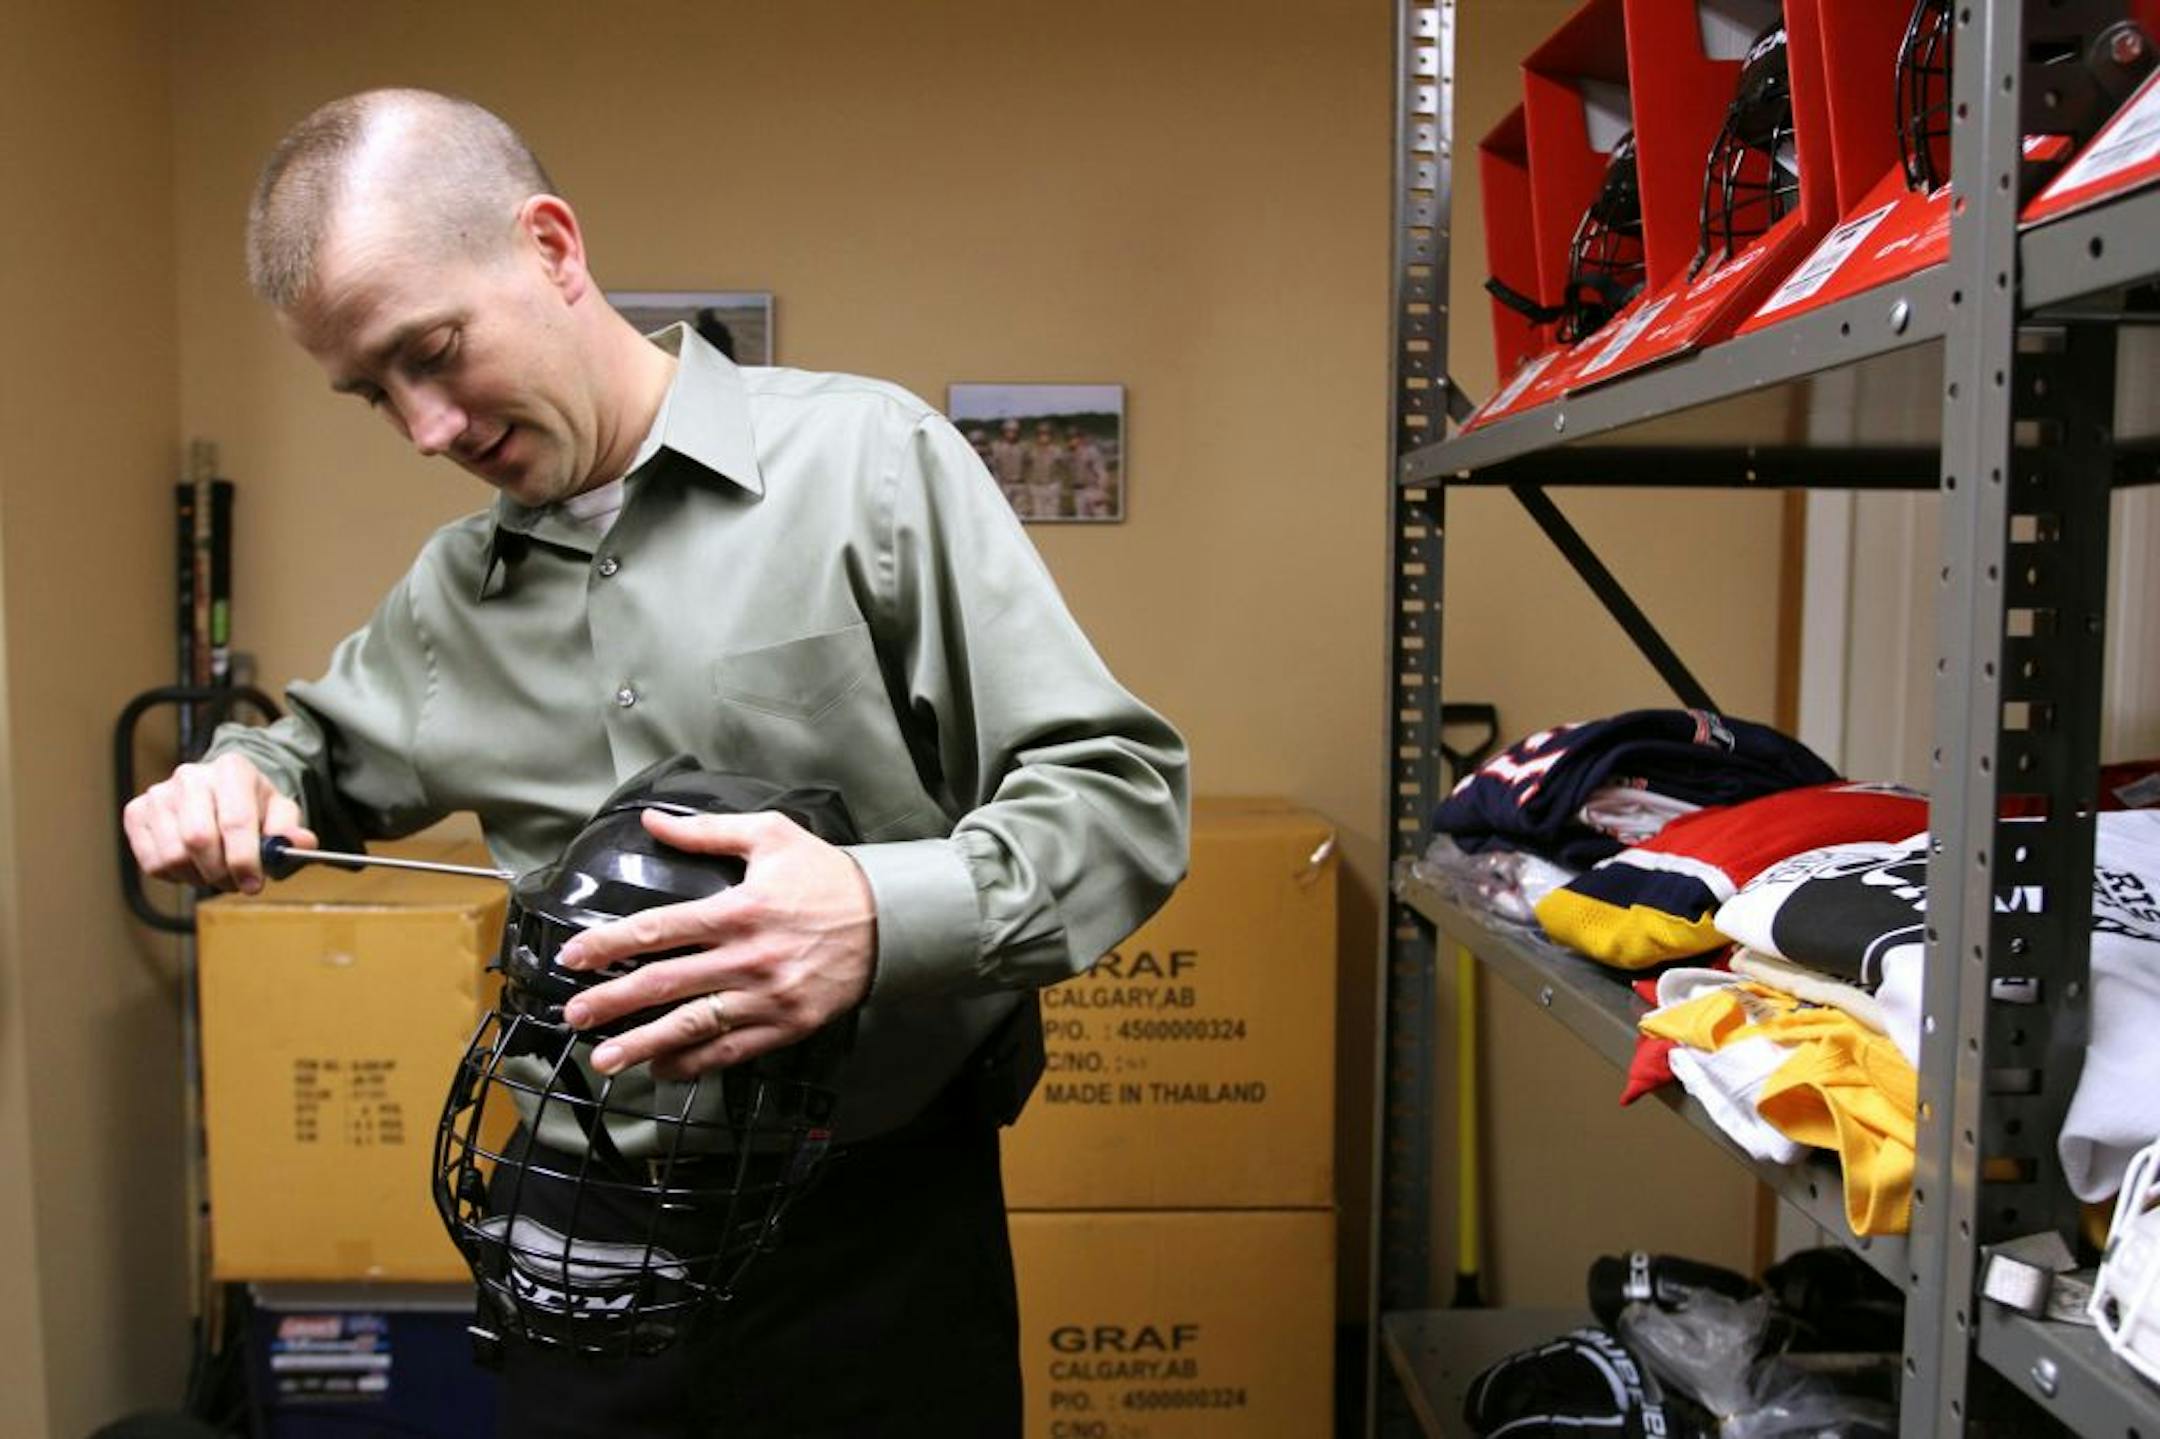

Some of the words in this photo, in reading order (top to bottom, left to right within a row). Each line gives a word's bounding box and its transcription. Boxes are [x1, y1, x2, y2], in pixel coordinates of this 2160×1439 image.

[1088, 950, 1199, 979] RAF
[1043, 986, 1196, 1010] CALGARY,AB
[1116, 1019, 1247, 1040] 4500000324
[1045, 1082, 1113, 1104] MADE
[1119, 1082, 1142, 1104] IN
[1149, 1080, 1267, 1103] THAILAND
[1050, 1324, 1199, 1352] GRAF
[1050, 1359, 1197, 1381] CALGARY,AB
